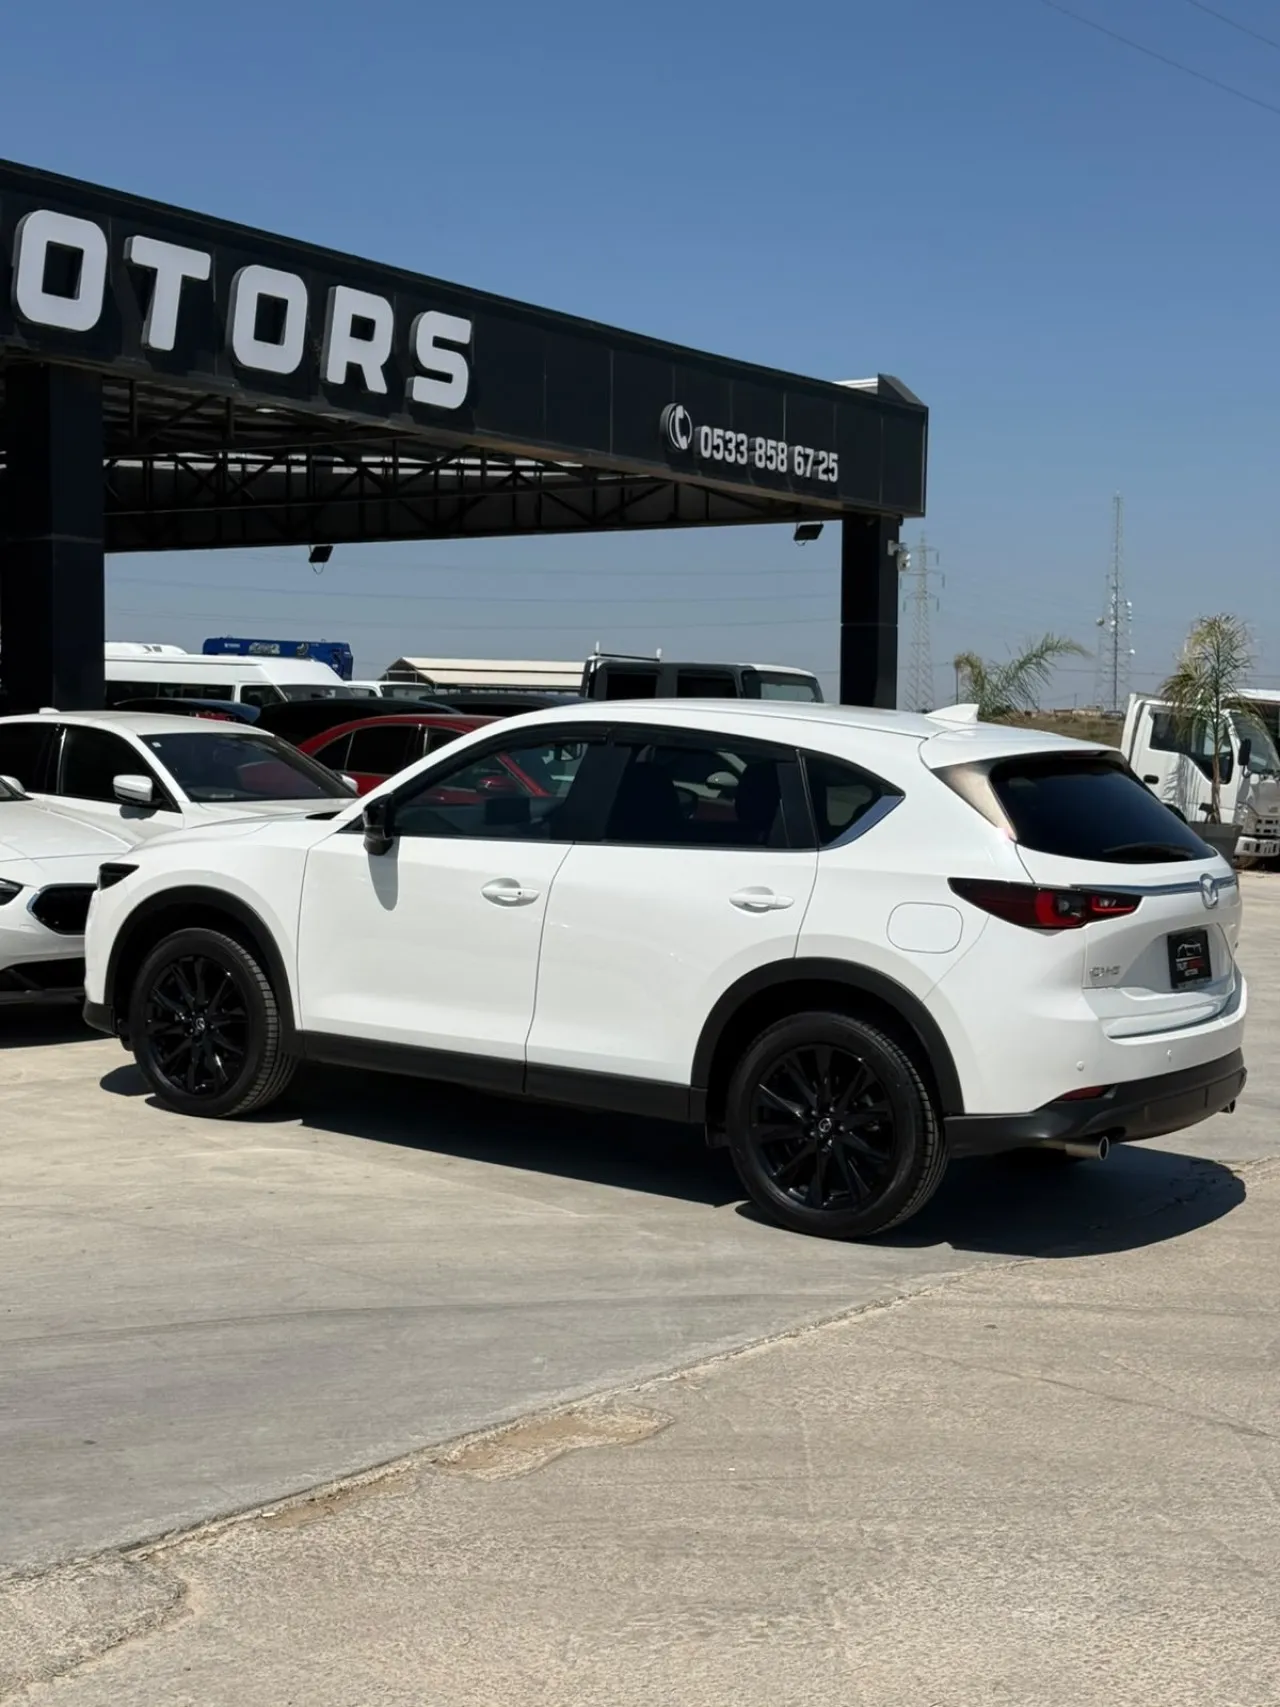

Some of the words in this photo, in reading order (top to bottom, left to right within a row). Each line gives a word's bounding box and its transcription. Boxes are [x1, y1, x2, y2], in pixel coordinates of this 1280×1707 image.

[12, 209, 473, 410] OTORS
[699, 425, 748, 465] 0533
[754, 437, 788, 473] 858
[794, 445, 815, 478] 67
[818, 450, 839, 483] 25
